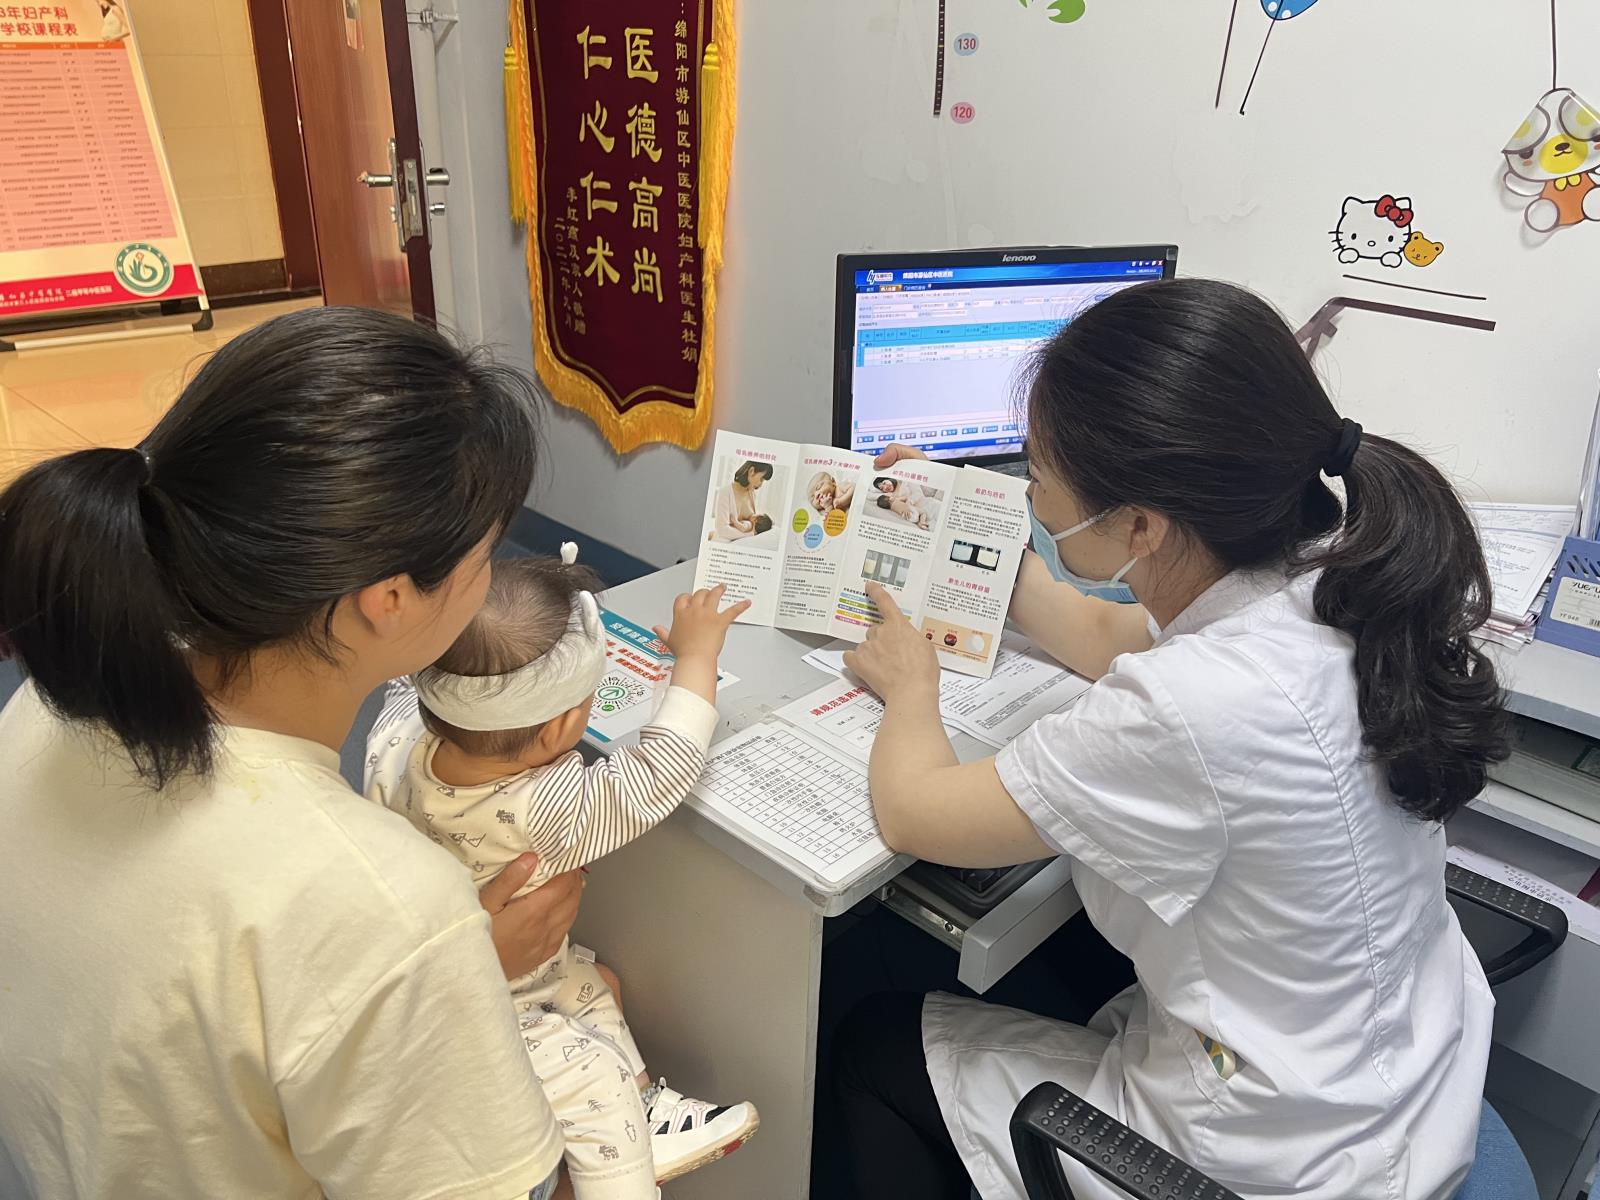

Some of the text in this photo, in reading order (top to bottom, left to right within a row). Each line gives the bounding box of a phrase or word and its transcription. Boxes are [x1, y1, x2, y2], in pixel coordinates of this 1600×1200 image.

[0, 22, 79, 37] 学校课程表
[957, 38, 977, 51] 130
[953, 106, 972, 119] 120
[576, 25, 620, 287] 仁心仁术
[624, 27, 664, 304] 医德高尚
[1002, 254, 1037, 262] lenovo
